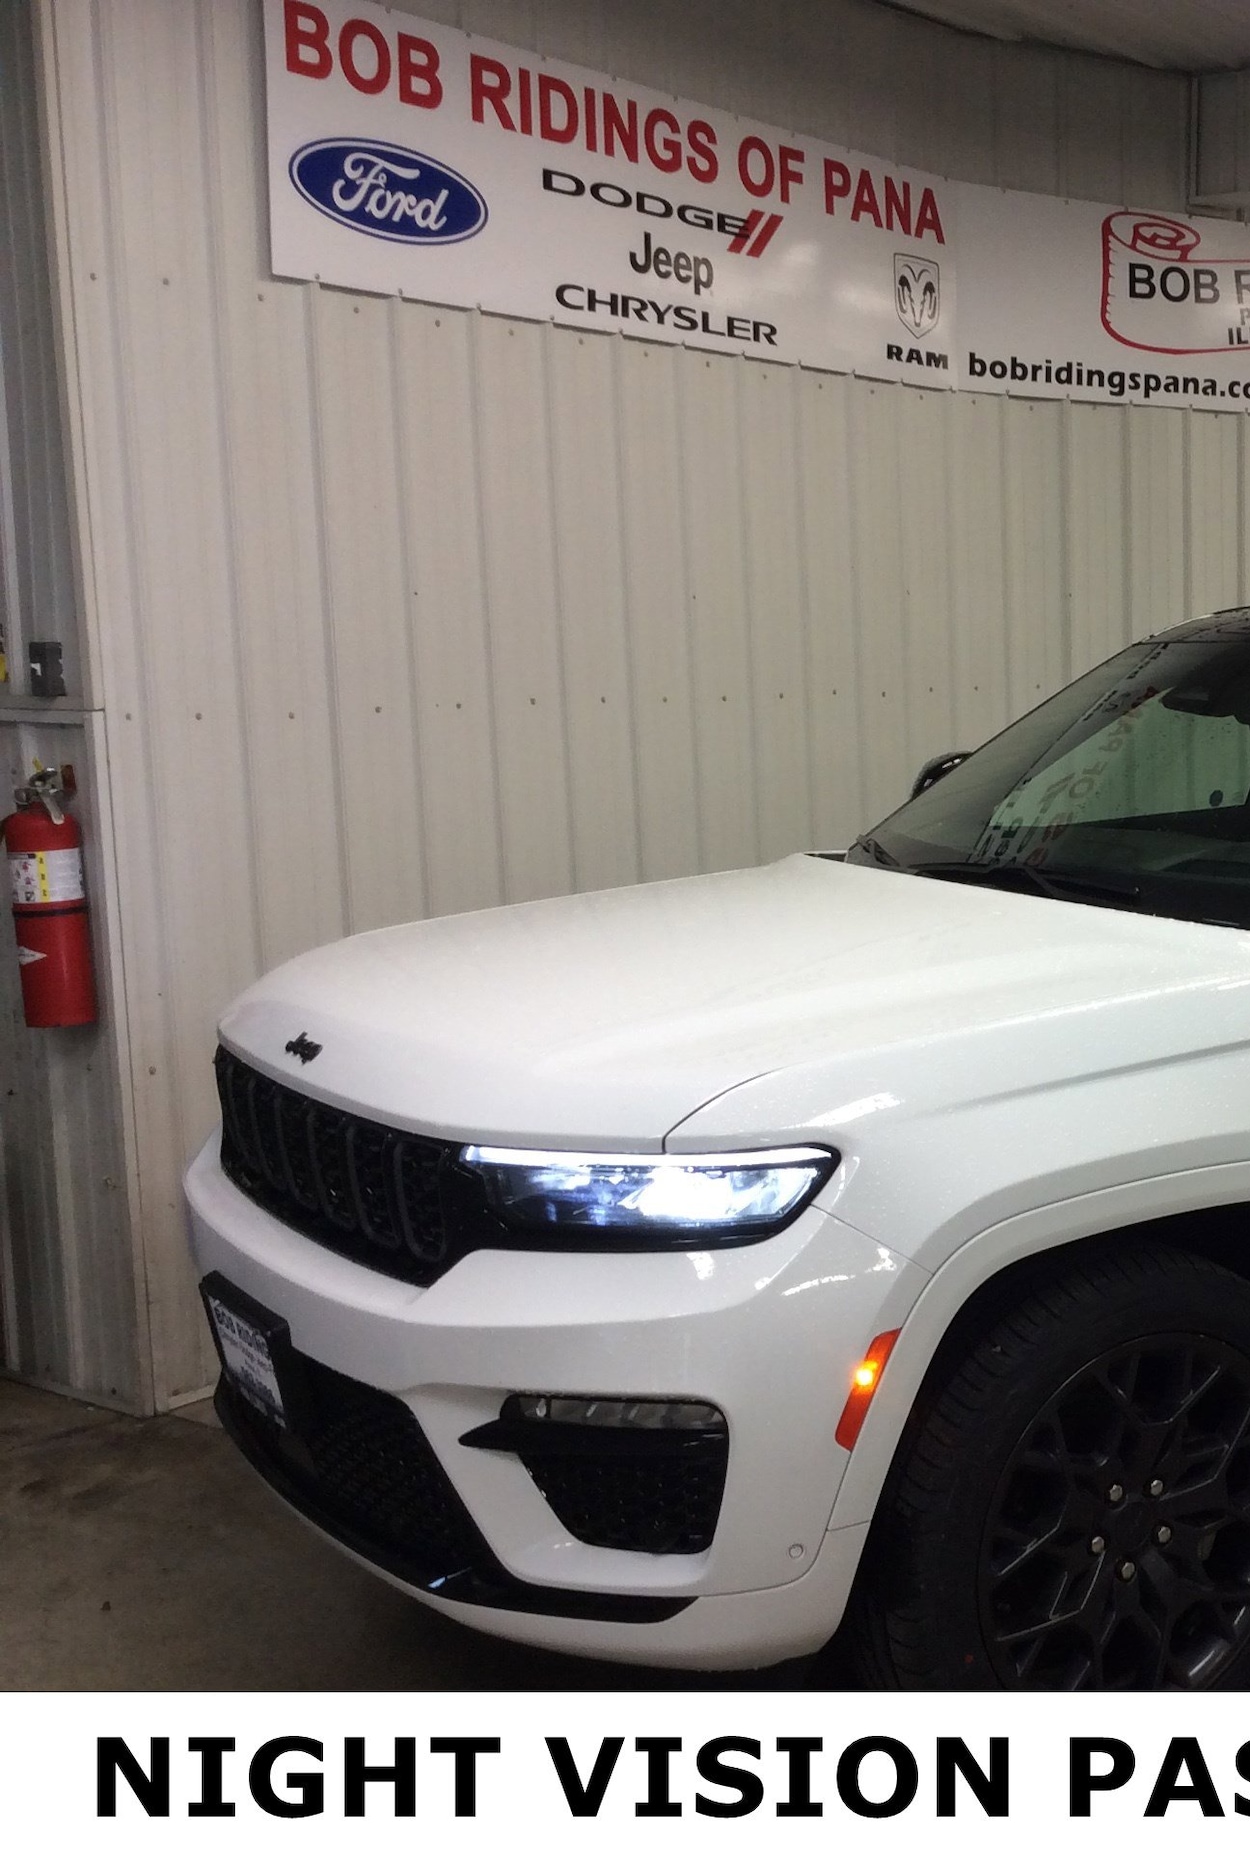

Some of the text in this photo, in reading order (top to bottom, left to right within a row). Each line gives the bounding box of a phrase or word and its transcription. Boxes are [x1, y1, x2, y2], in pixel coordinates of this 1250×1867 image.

[284, 0, 945, 243] BOB RIDINGS OF PANA
[332, 152, 449, 230] Ford
[543, 168, 750, 239] DODGE
[629, 231, 714, 295] Jeep
[1129, 262, 1220, 304] BOB
[555, 283, 778, 346] CHRYSLER
[887, 343, 948, 369] RAM
